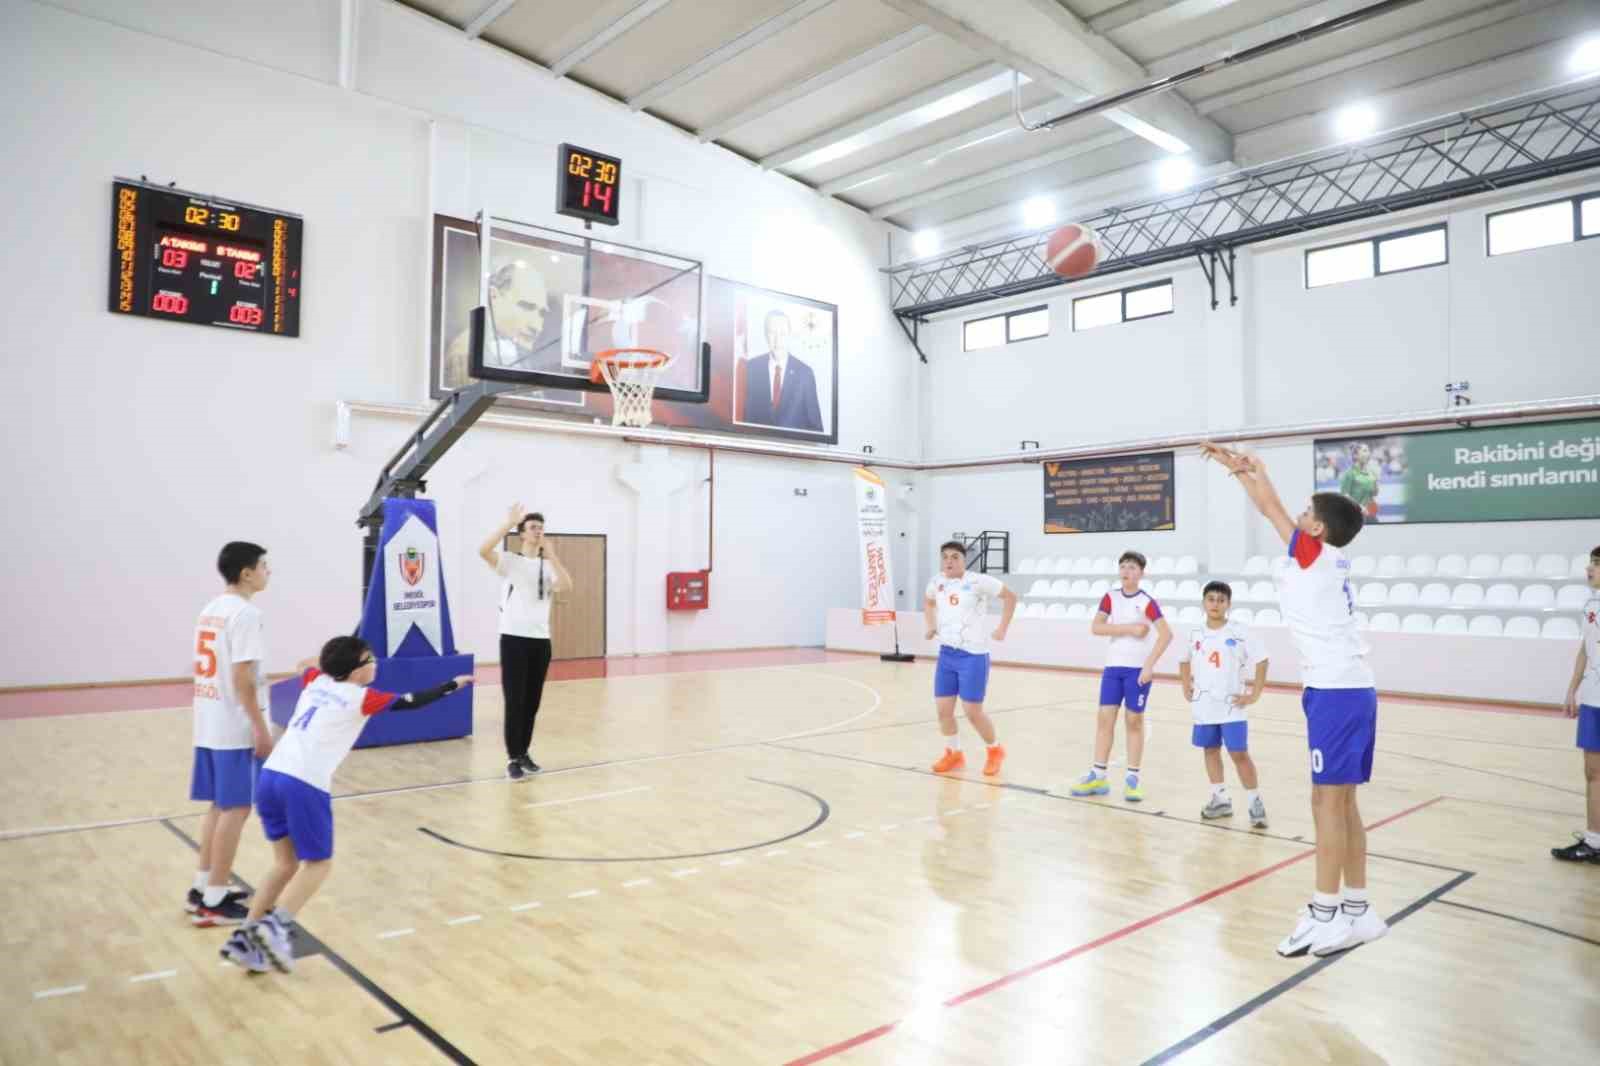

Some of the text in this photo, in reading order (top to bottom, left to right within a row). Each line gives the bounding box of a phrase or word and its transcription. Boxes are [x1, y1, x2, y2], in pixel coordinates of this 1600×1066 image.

[583, 180, 613, 213] 14
[185, 206, 240, 231] 02:30
[162, 249, 187, 269] 03
[234, 260, 257, 279] 02
[153, 294, 189, 314] 000
[230, 304, 263, 325] 003
[1454, 441, 1545, 465] Rakibini
[1427, 466, 1598, 491] kendi sınırlarını
[949, 593, 959, 606] 6
[193, 630, 218, 678] 5
[1208, 651, 1221, 669] 4
